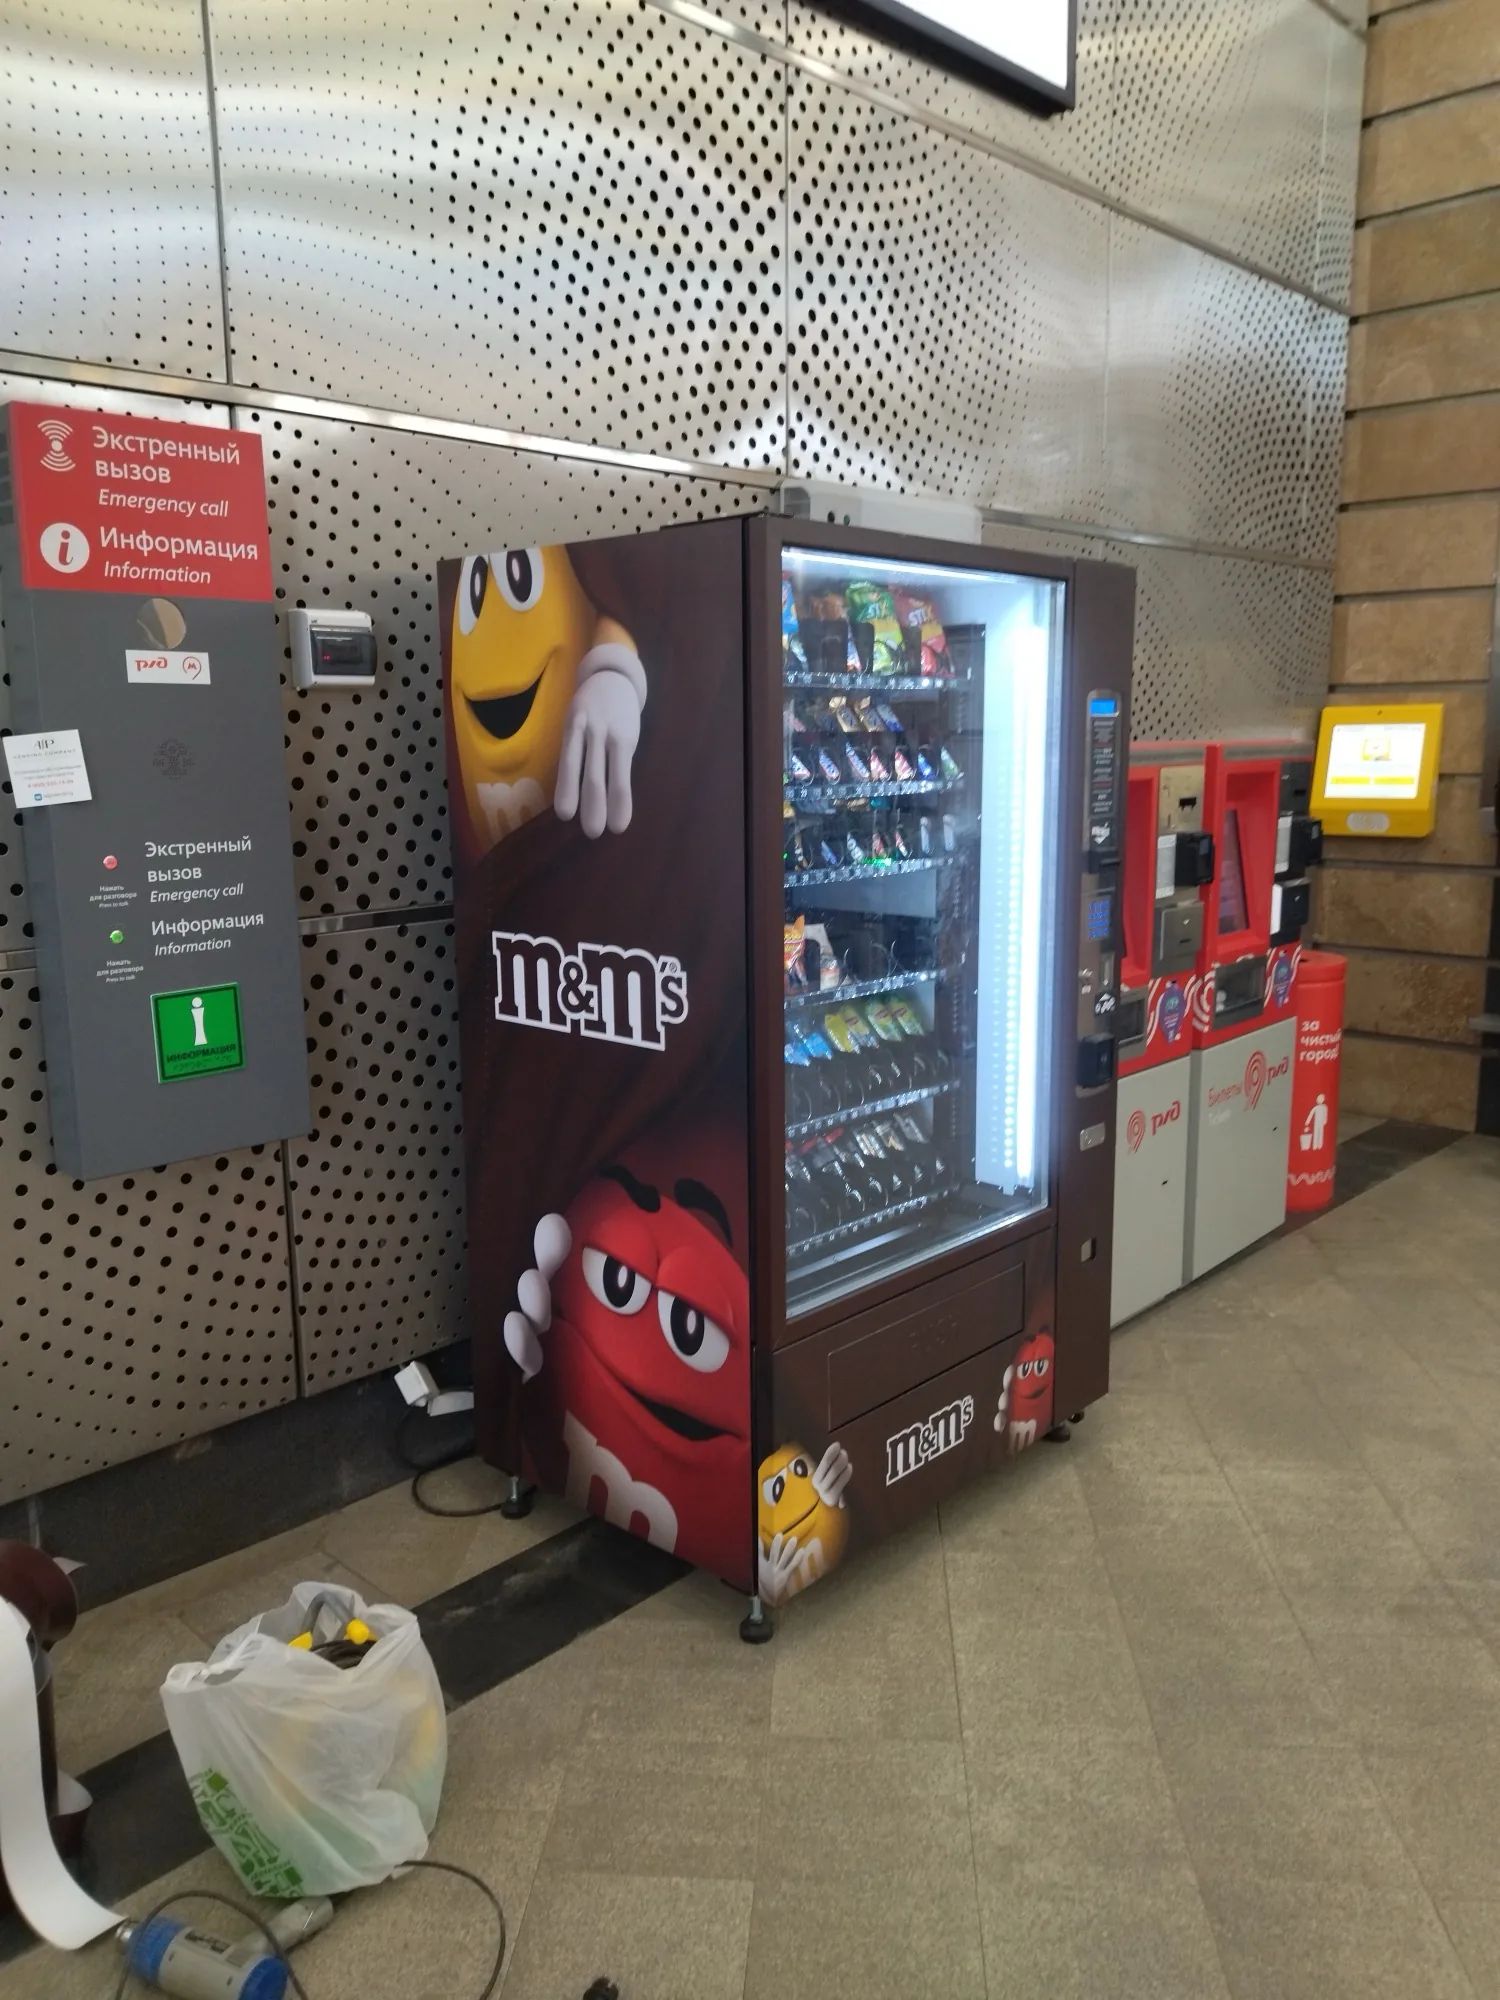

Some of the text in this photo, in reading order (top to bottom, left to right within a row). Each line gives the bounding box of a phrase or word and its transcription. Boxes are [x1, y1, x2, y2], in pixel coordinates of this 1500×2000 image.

[92, 426, 241, 465] Экстренный
[95, 460, 172, 484] вызов
[98, 489, 230, 518] Emergency call
[99, 526, 259, 561] Информация
[103, 561, 212, 584] Information
[144, 834, 252, 858] Экстренный
[147, 867, 203, 883] вызов
[99, 885, 125, 893] Нажать
[103, 892, 138, 901] разговора
[149, 883, 244, 903] Emergency call
[151, 914, 265, 936] Информация
[154, 938, 232, 957] Information
[106, 959, 131, 967] Нажать
[109, 965, 144, 975] разговора
[1300, 1020, 1321, 1032] за
[166, 1044, 236, 1063] ИНФОРМАЦИЯ
[1299, 1042, 1340, 1065] город
